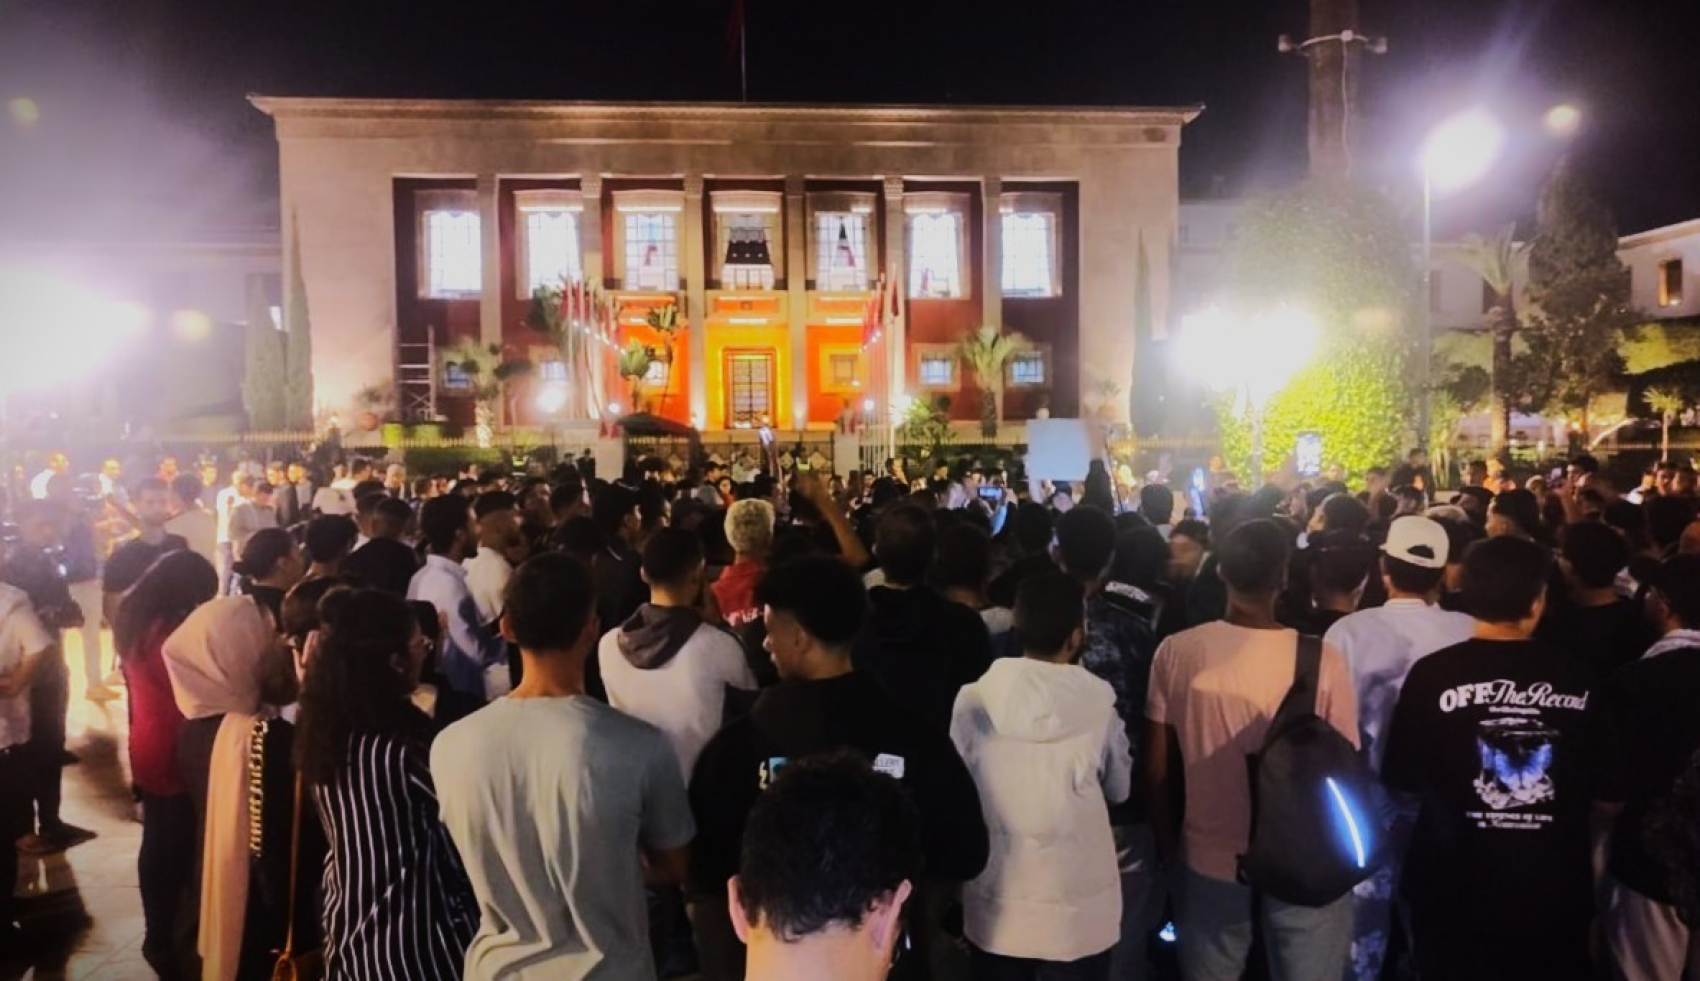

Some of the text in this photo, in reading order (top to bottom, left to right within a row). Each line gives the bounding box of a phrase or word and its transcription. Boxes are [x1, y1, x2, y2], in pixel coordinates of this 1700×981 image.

[1440, 679, 1589, 712] OFF The Record
